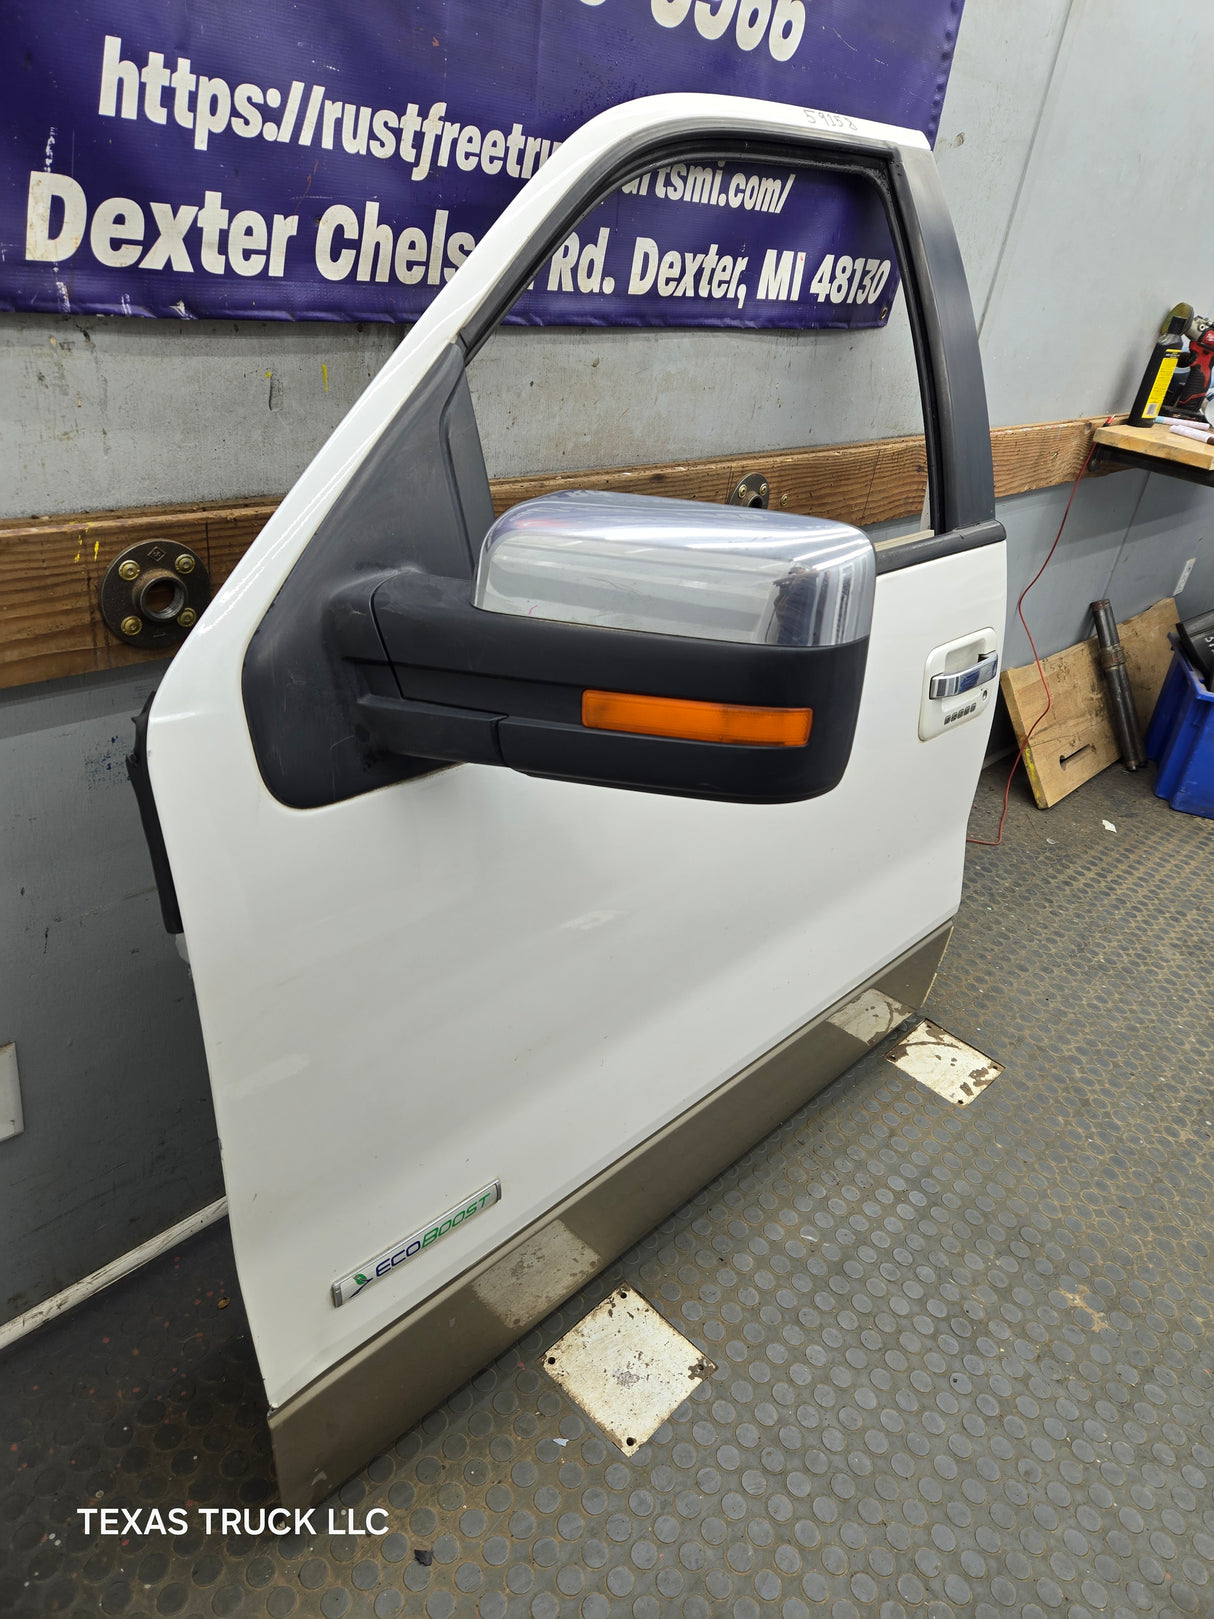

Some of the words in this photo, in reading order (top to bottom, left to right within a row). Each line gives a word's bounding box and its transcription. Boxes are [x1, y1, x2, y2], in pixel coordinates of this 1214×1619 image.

[650, 0, 806, 62] 66
[25, 170, 299, 277] Dexter
[315, 201, 535, 290] Chels
[547, 227, 616, 295] Rd.
[628, 237, 749, 309] Dexter,
[756, 249, 807, 301] MI
[810, 254, 892, 304] 48130
[375, 1192, 491, 1277] ECOBOOST
